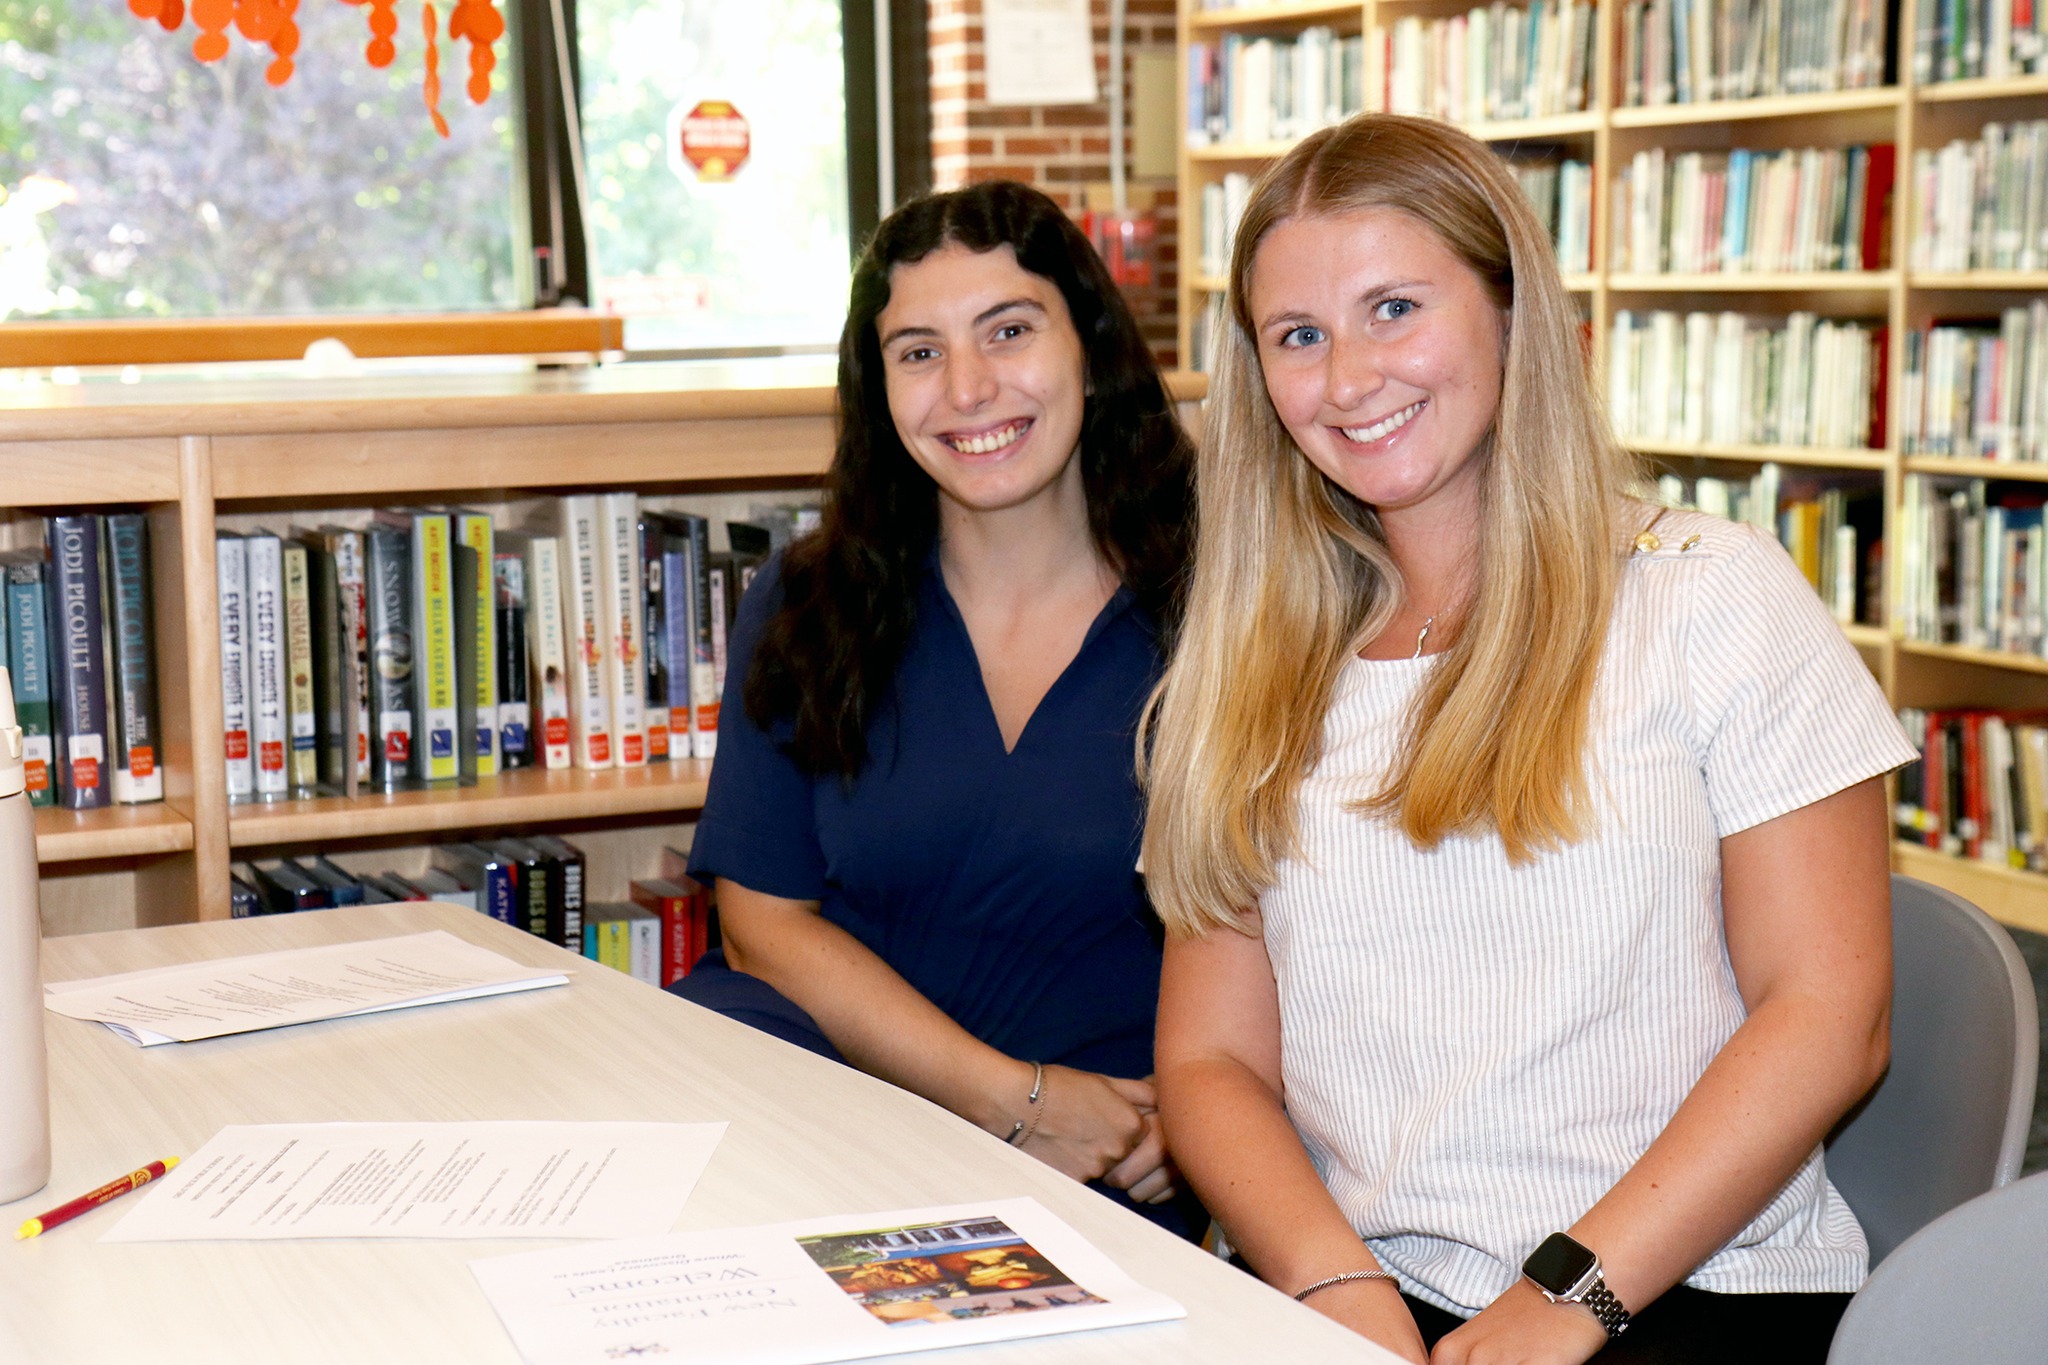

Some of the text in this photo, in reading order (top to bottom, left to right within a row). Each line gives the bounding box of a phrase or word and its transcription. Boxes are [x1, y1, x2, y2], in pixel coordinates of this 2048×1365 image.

[114, 525, 138, 577] JODI
[224, 592, 241, 646] EVERY
[257, 591, 275, 644] EVERY
[385, 561, 402, 630] SNOW
[15, 593, 38, 695] JODI PICOULT
[62, 525, 91, 731] JODI PICOULT HOUSE
[121, 583, 146, 680] PICOULT
[529, 870, 547, 915] BONES
[565, 865, 581, 908] BONES
[565, 911, 581, 936] ARE
[567, 1267, 759, 1298] Welcome!
[591, 1286, 777, 1313] Orientation
[594, 1298, 798, 1328] New Faculty
